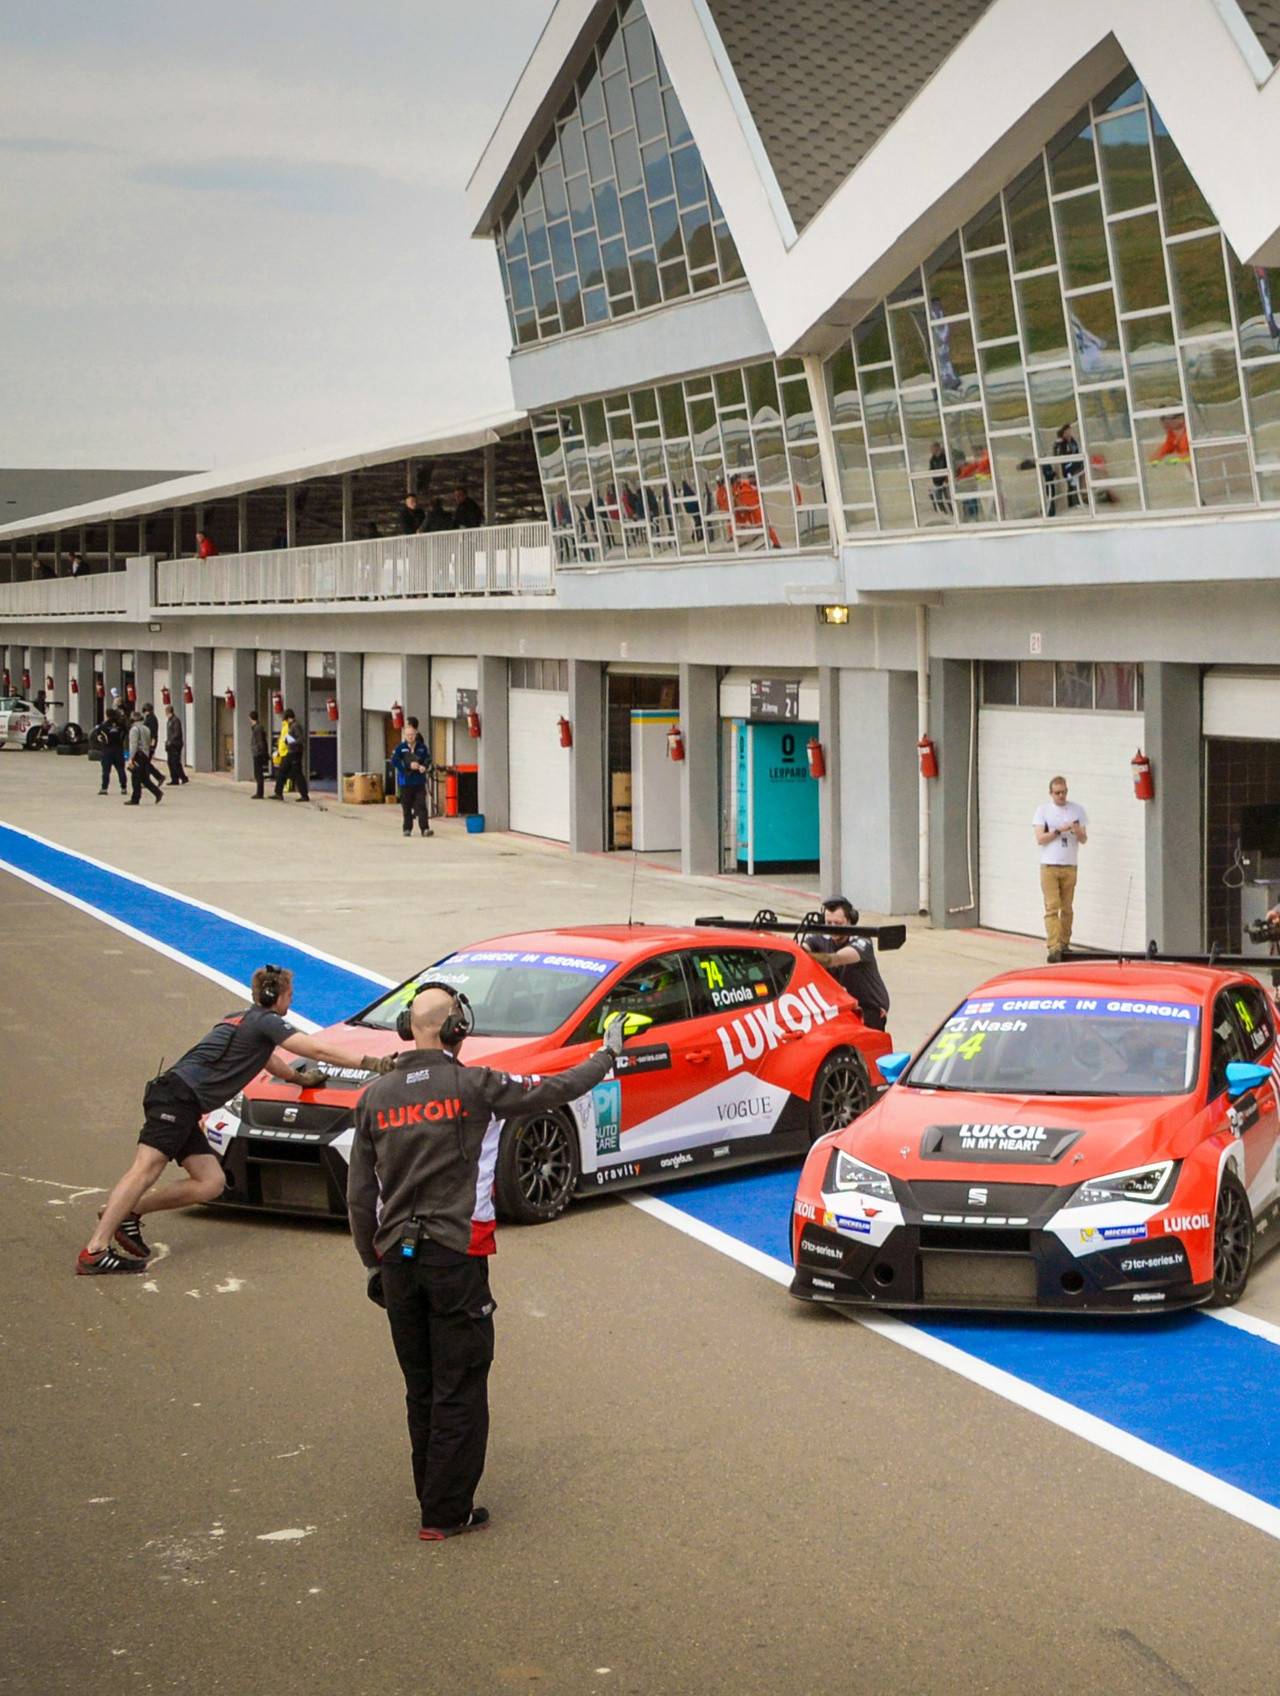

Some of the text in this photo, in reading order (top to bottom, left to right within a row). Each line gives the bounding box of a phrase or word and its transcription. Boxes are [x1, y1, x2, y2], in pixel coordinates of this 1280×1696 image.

[769, 767, 806, 778] LEOPARD
[470, 953, 607, 973] CHECK IN GEORGIA
[700, 961, 724, 989] 74
[712, 986, 754, 1007] P.Oriola
[1002, 1000, 1191, 1019] CHECK IN GEORGIA
[716, 983, 839, 1071] LUKOIL
[930, 1033, 986, 1061] 54
[340, 1068, 370, 1080] HEART
[377, 1098, 469, 1130] LUKOIL
[717, 1096, 773, 1121] VOGUE
[959, 1124, 1048, 1140] LUKOIL
[962, 1138, 1040, 1151] IN MY HEART
[597, 1164, 641, 1184] gravity
[838, 1217, 871, 1230] MICHELIN
[1104, 1226, 1146, 1236] MICHELIN
[1164, 1214, 1210, 1233] LUKOIL
[1133, 1253, 1184, 1269] tcr-series.tv
